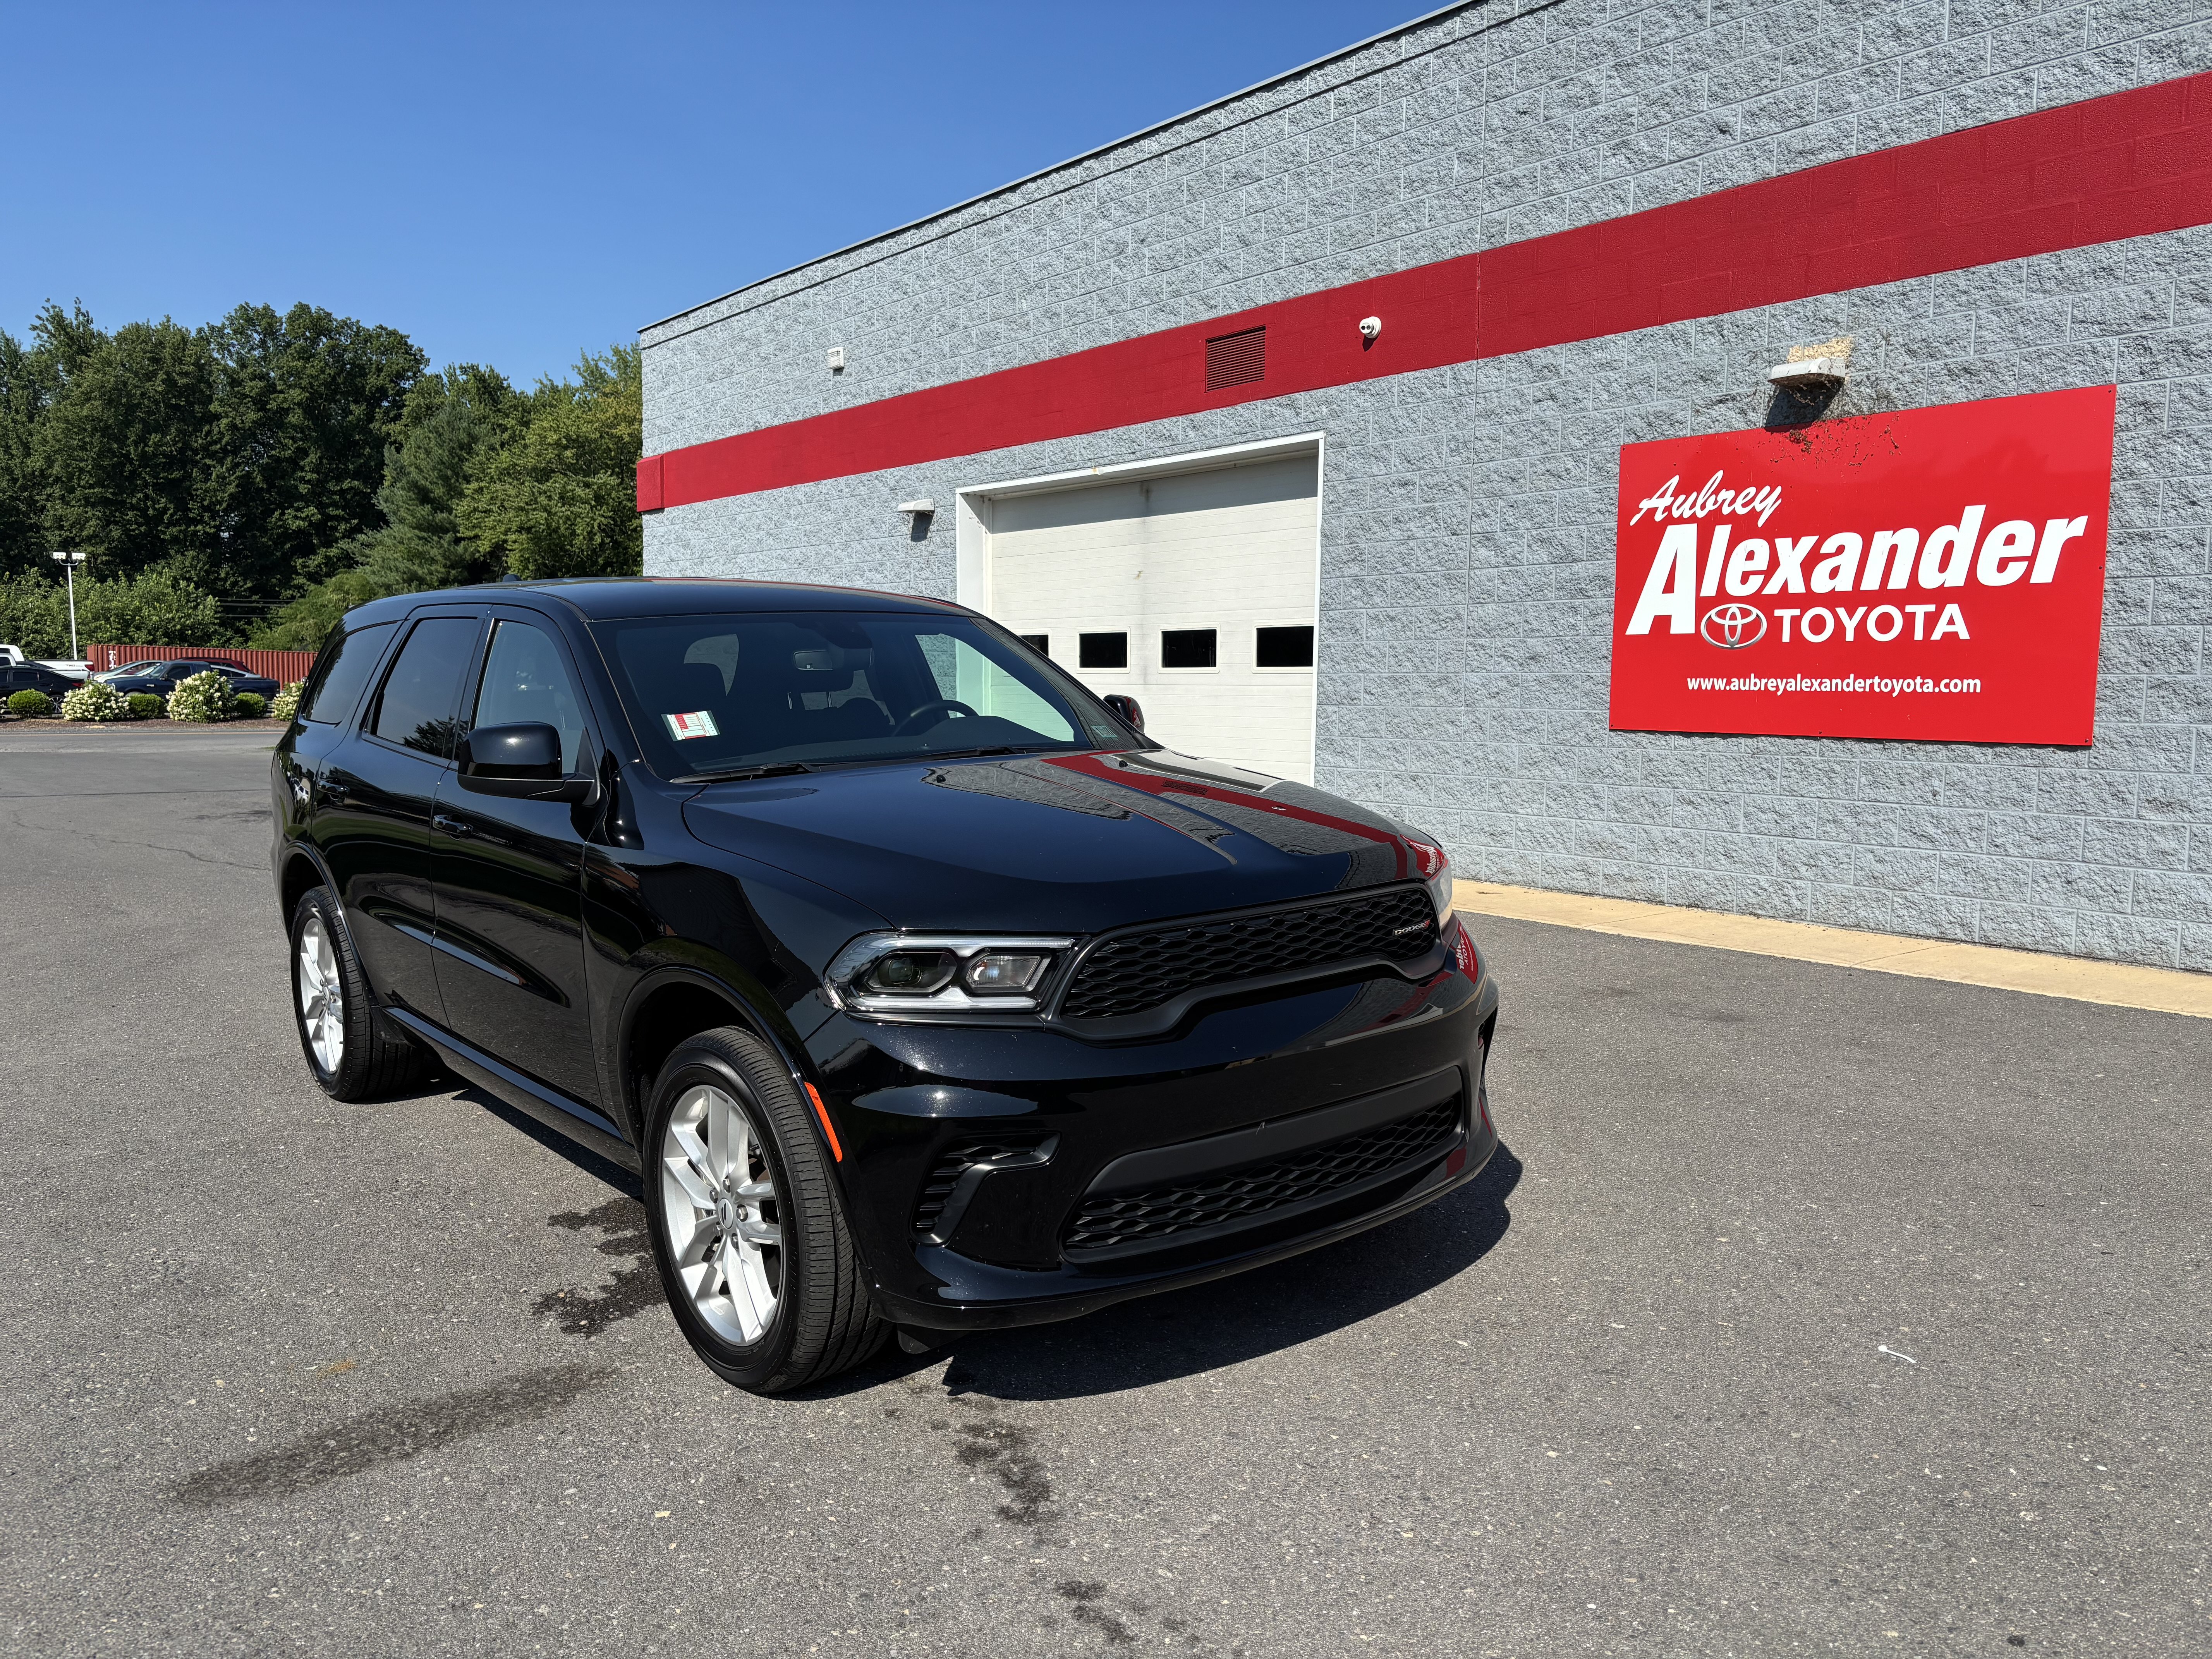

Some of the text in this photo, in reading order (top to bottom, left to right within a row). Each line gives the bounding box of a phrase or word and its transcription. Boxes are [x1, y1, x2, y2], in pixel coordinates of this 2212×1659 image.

[1630, 470, 1782, 528] Aubrey
[1625, 504, 2088, 635] Alexander
[1774, 603, 1970, 643] TOYOTA
[1687, 673, 1981, 697] www.aubreyalexandertoyota.com
[1395, 922, 1427, 935] DODGE
